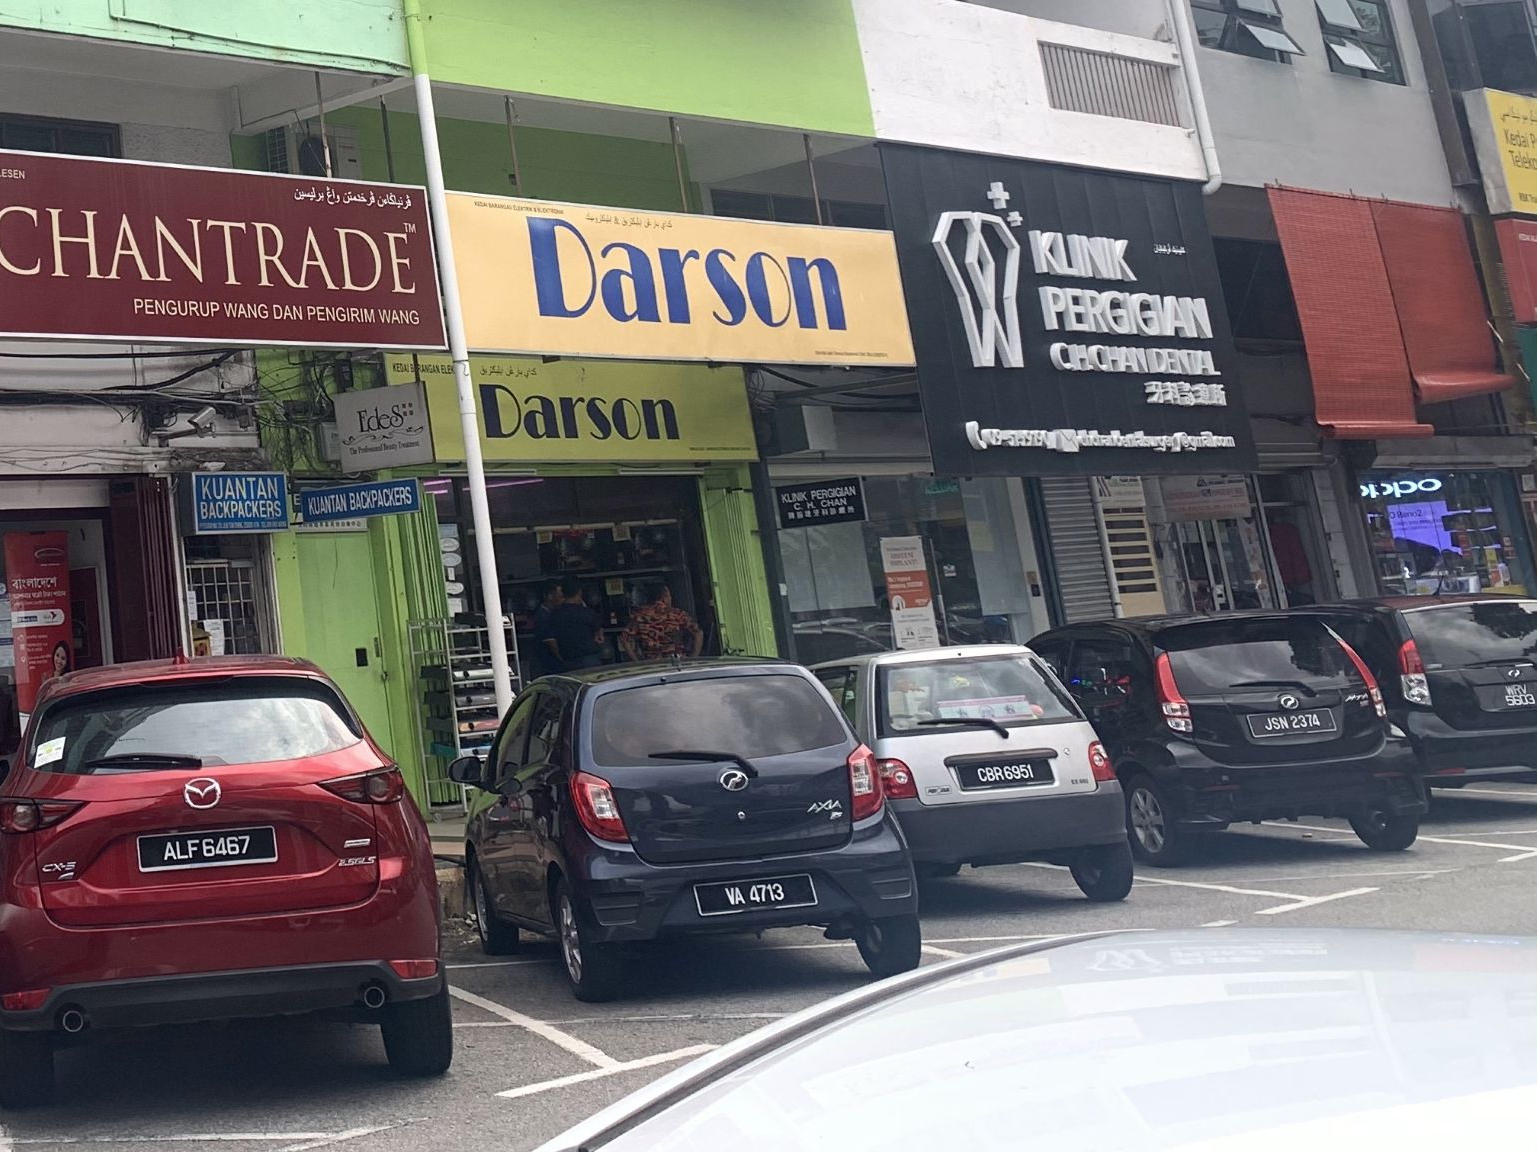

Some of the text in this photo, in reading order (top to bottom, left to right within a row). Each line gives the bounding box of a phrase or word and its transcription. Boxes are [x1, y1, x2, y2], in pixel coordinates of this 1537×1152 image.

[1503, 128, 1530, 148] Kedai
[1028, 230, 1138, 281] KLINIK
[525, 215, 848, 332] Darson
[133, 299, 420, 325] PENGURUP WANG DAN PENGIRIM WANG
[1038, 285, 1214, 338] PERGIGIAN
[392, 363, 410, 372] KEDAI
[411, 364, 441, 375] BRANGAN
[1145, 348, 1221, 376] DENTAL
[479, 384, 680, 440] Darson
[201, 477, 279, 500] KUANTAN
[781, 485, 857, 504] KLINIK PERGIGIAN
[200, 500, 283, 520] BACKPACKERS
[308, 493, 348, 515] KUANTAN
[349, 486, 413, 511] BACKPACKERS
[820, 497, 847, 508] CHAN
[1505, 684, 1527, 695] WRV
[1505, 693, 1536, 706] 5603
[1264, 713, 1321, 731] JSN 2374
[807, 799, 842, 813] AXIA
[163, 835, 251, 862] ALF 6467
[42, 861, 76, 872] CX-5
[725, 882, 785, 905] VA 4713
